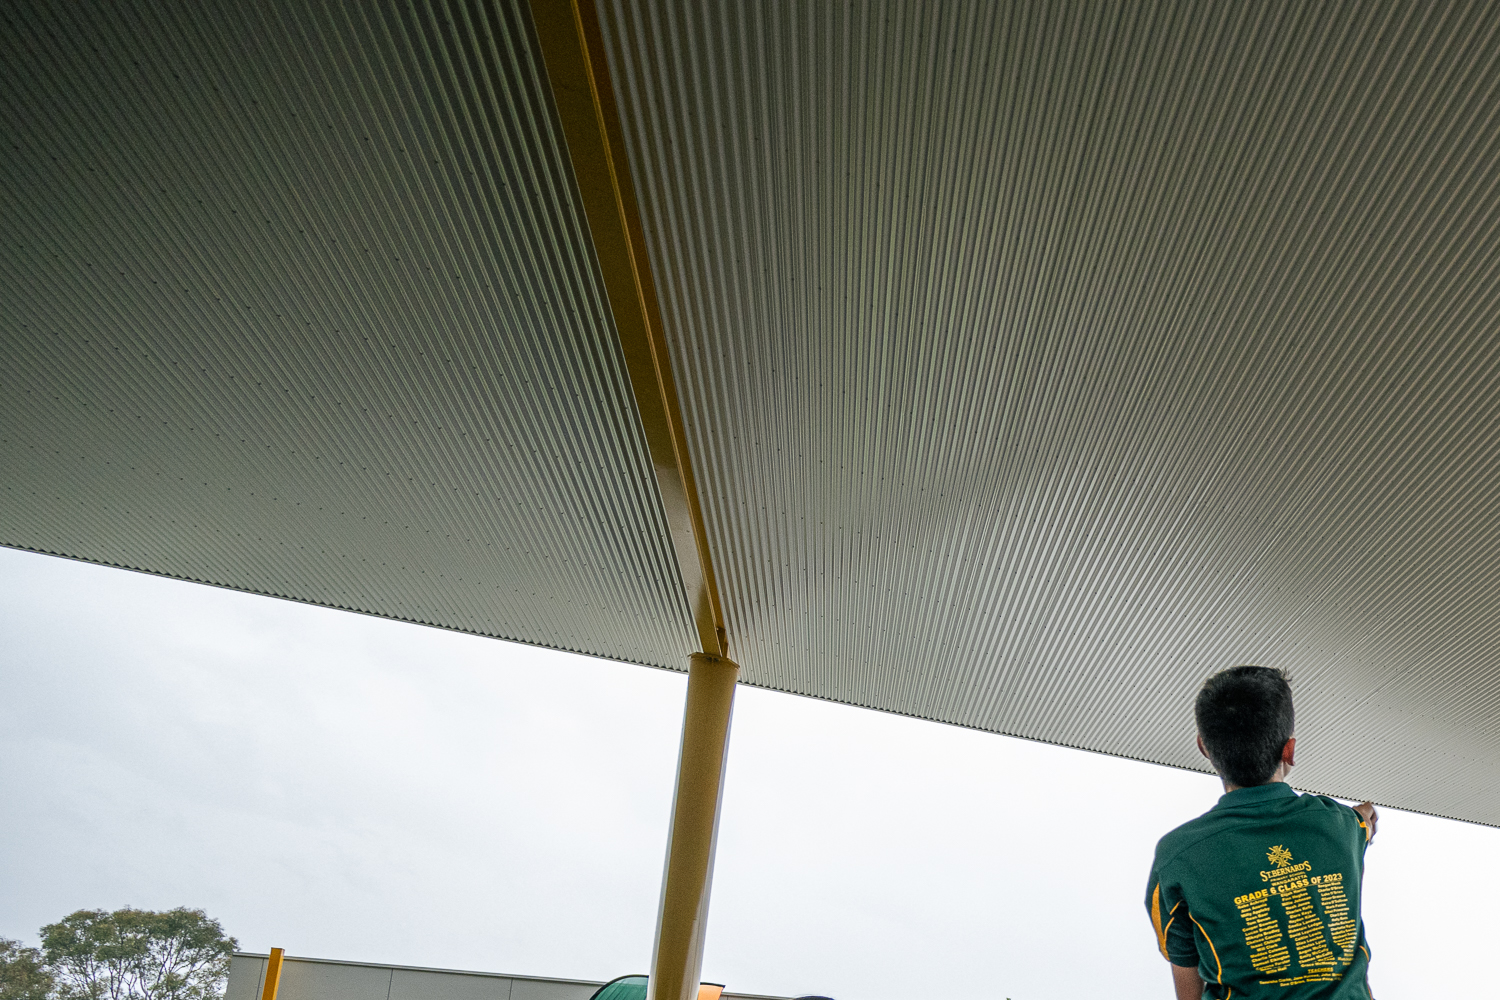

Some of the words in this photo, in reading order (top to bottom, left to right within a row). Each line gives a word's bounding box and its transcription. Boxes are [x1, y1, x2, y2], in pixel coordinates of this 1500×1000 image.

[1234, 889, 1268, 905] GRADE
[1278, 879, 1309, 892] CLASS
[1323, 873, 1342, 882] 2023
[1271, 875, 1307, 886] WANGARATTA
